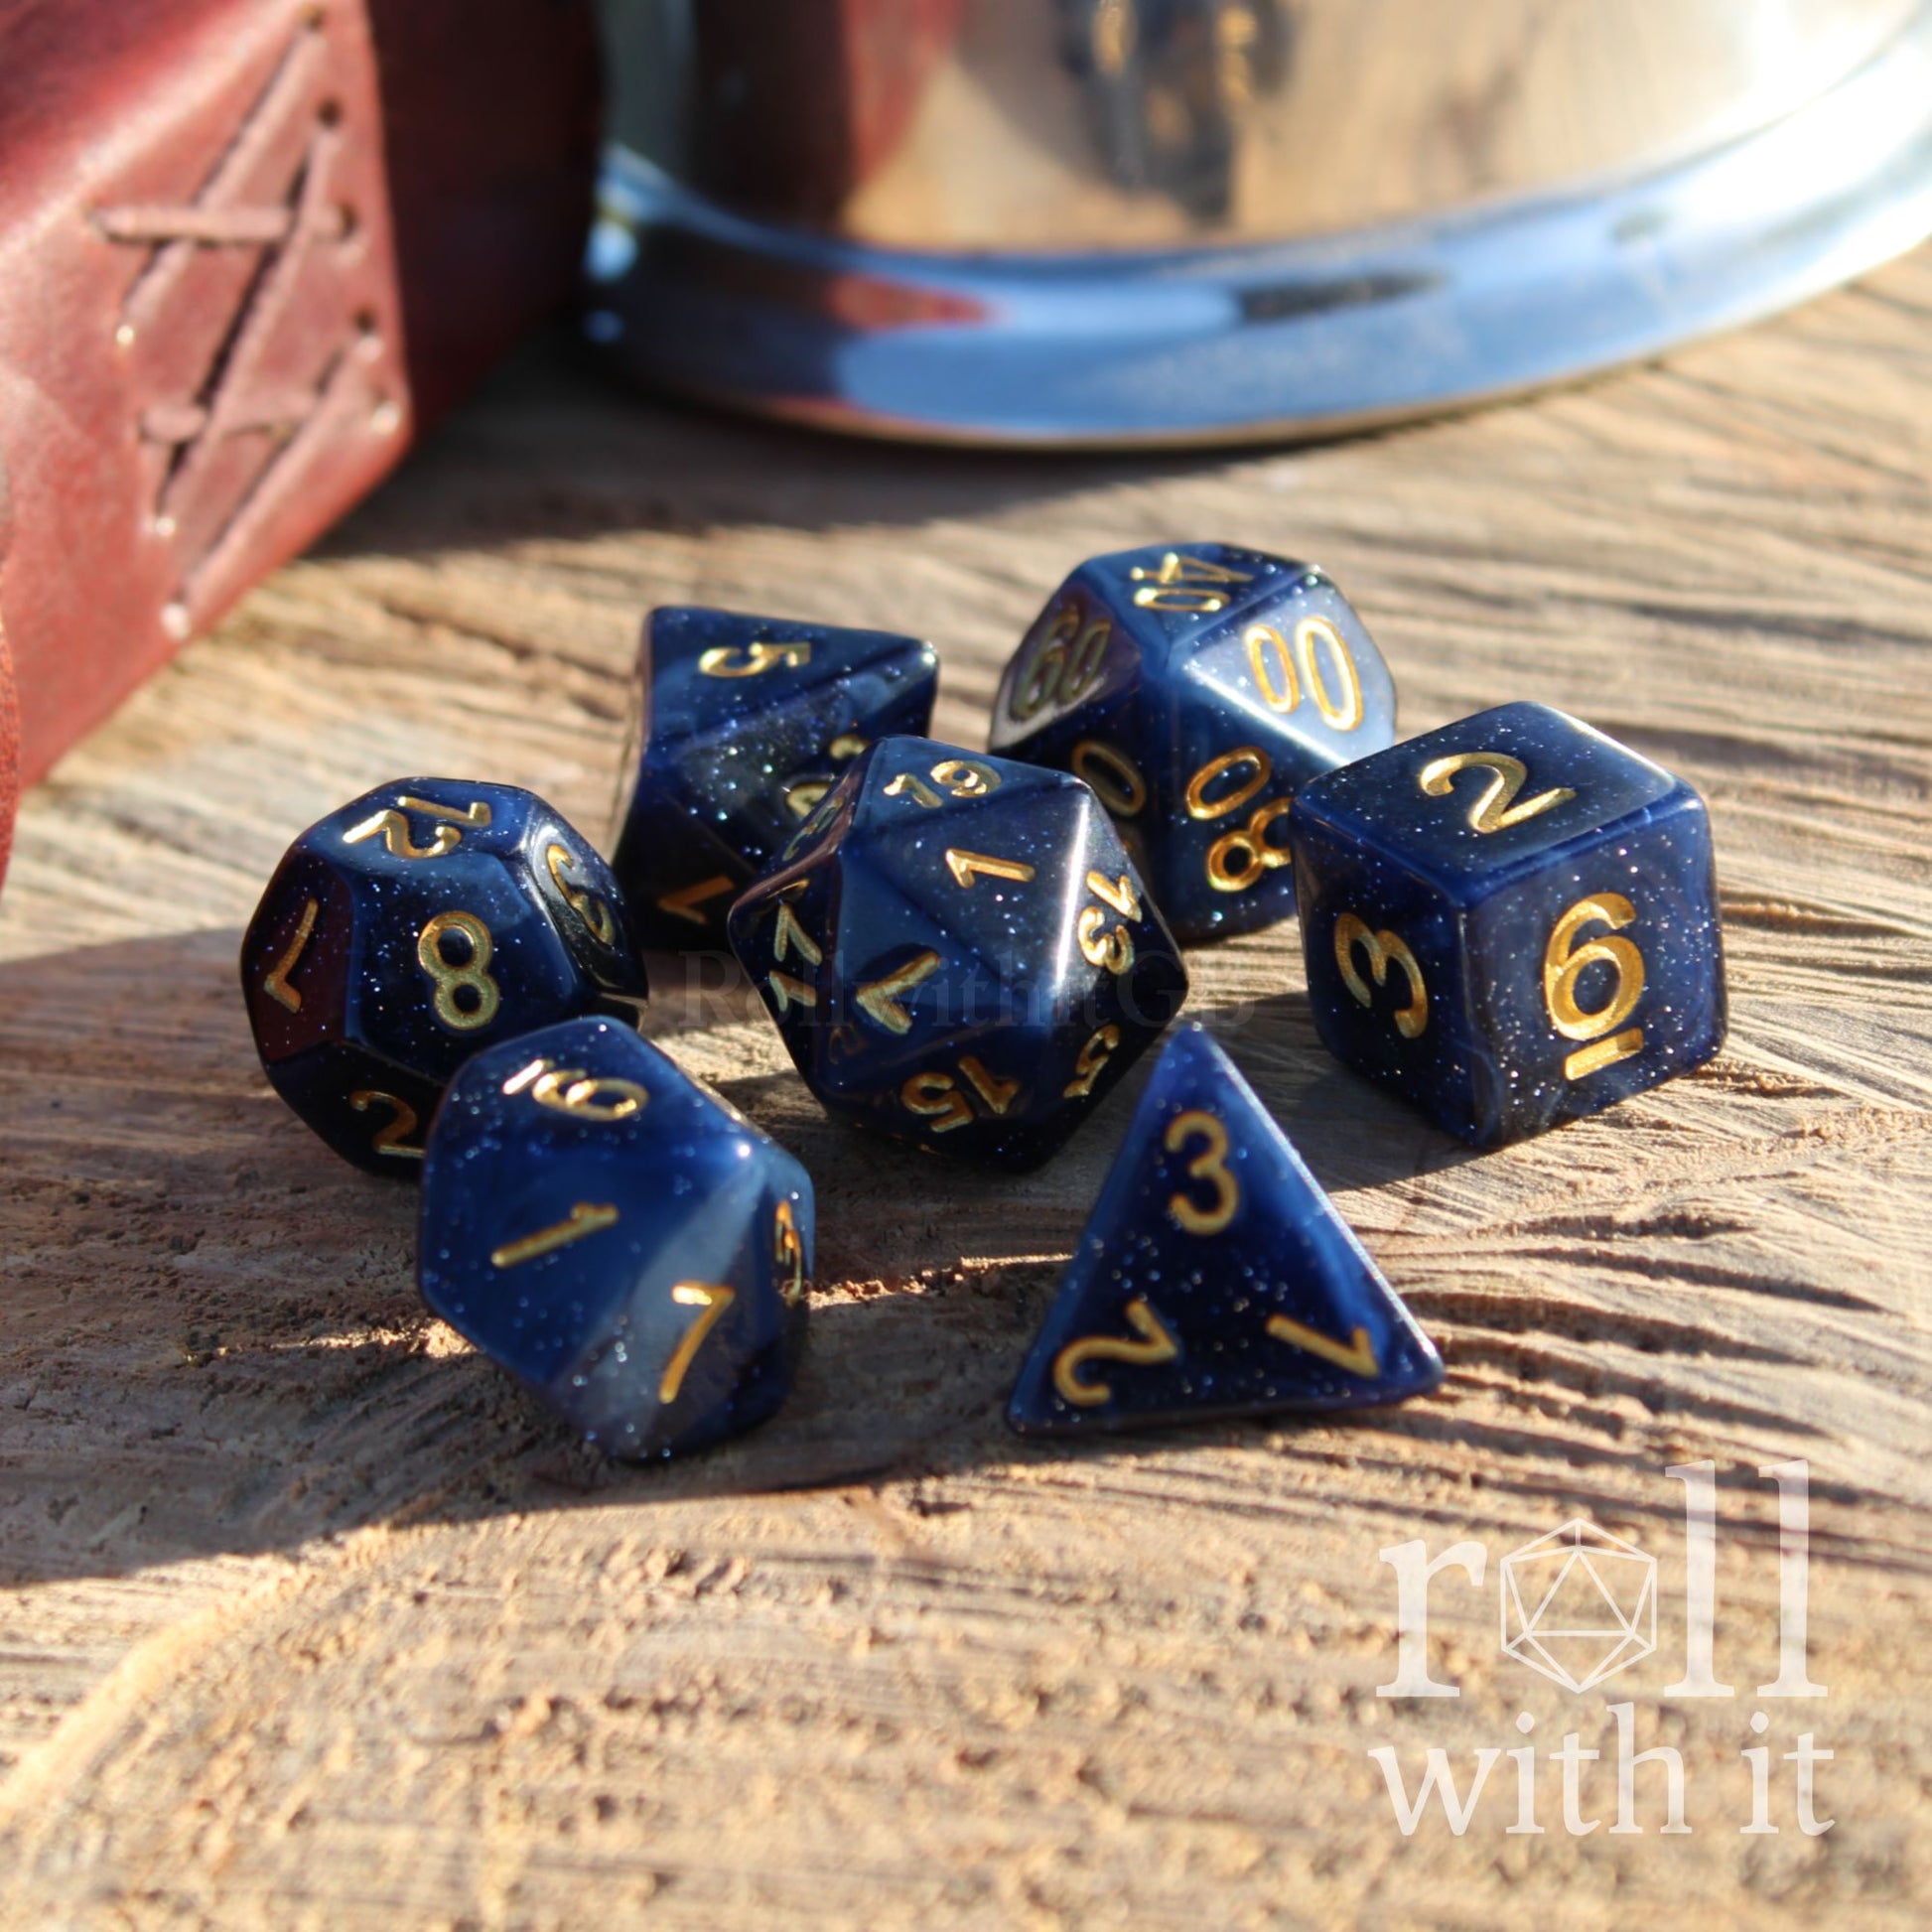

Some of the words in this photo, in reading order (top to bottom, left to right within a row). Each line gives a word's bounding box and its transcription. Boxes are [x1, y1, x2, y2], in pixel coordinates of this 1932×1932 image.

[698, 641, 811, 678] 5
[1244, 616, 1364, 732] 00
[884, 759, 1002, 809] 19
[1420, 751, 1578, 834] 2
[343, 796, 491, 860] 12
[945, 848, 1036, 889] 1
[1076, 870, 1143, 976] 13
[418, 911, 499, 1030] 8
[1334, 912, 1428, 1038] 3
[900, 1054, 1022, 1133] 15
[1062, 1024, 1121, 1099] 5
[1165, 1110, 1240, 1236] 3
[490, 1201, 620, 1268] 1
[671, 1278, 736, 1404] 7
[1053, 1298, 1178, 1407] 2
[1265, 1312, 1380, 1378] 1
